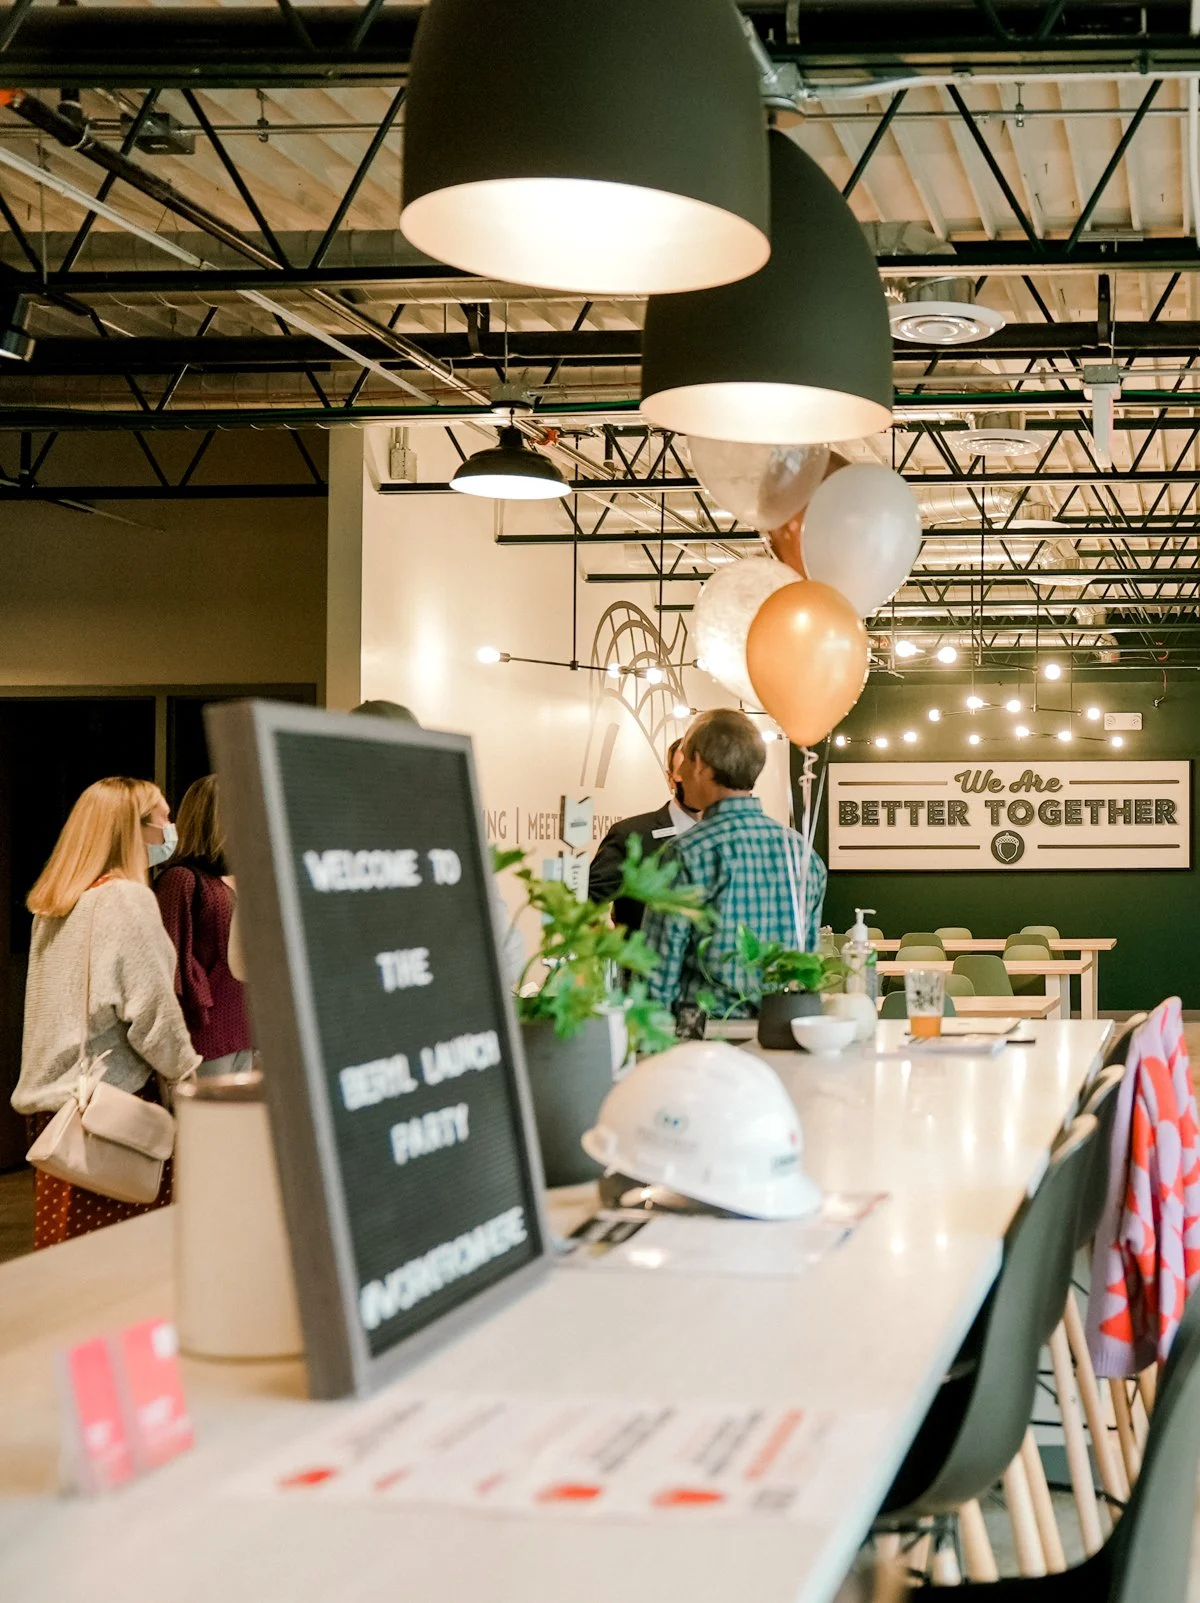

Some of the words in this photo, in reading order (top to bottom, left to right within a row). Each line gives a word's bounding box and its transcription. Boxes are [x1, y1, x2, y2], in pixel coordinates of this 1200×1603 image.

[954, 769, 1005, 794] We
[1008, 769, 1063, 793] Are
[527, 812, 561, 841] MEET
[838, 800, 971, 827] BETTER
[984, 799, 1179, 826] TOGETHER
[303, 849, 423, 891] WELCOME
[427, 848, 462, 885] TO
[375, 946, 434, 993] THE
[420, 1029, 501, 1086] LAUNCH
[390, 1102, 469, 1165] PARTY
